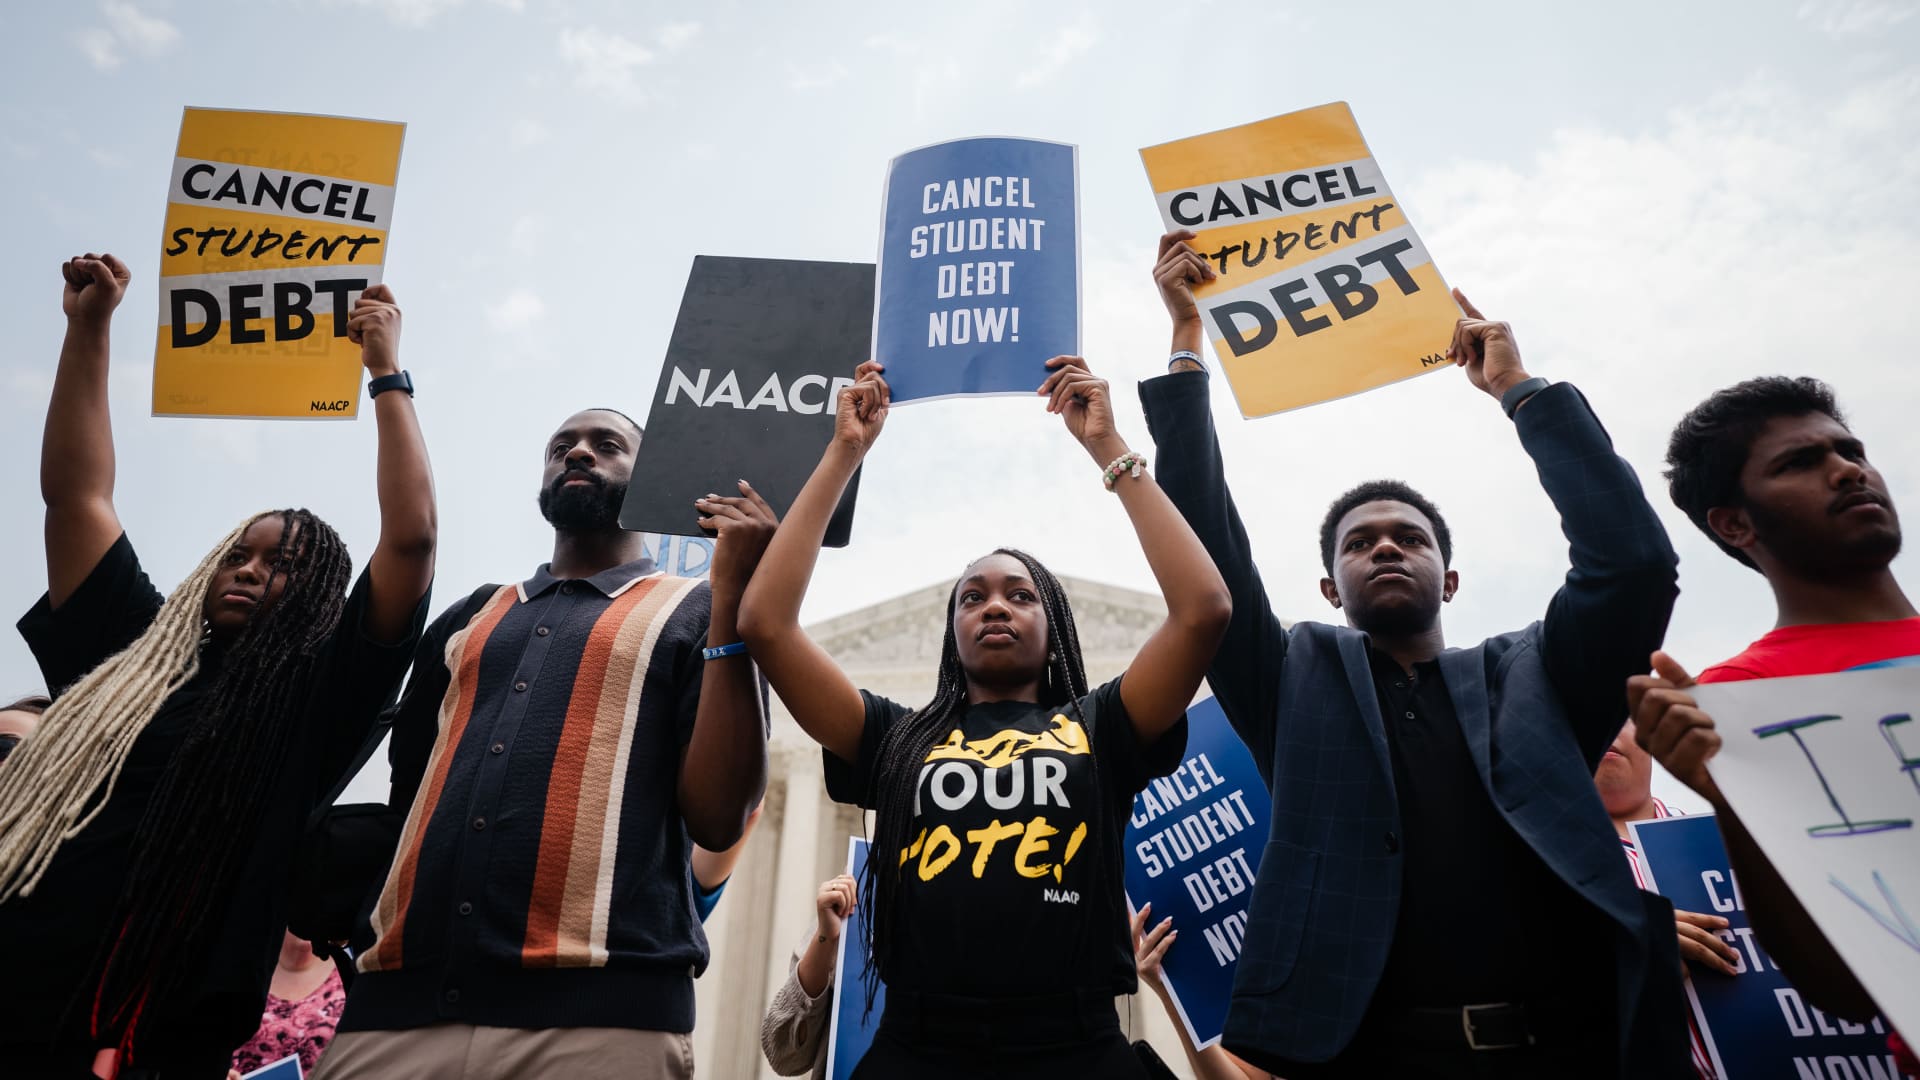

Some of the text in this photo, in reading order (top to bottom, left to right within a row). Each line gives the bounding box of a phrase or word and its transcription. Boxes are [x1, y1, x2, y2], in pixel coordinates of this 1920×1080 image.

[182, 164, 376, 223] CANCEL
[922, 176, 1035, 214] CANCEL
[1170, 166, 1376, 226] CANCEL
[166, 227, 380, 263] STUDENT
[910, 218, 1045, 258] STUDENT
[1196, 203, 1394, 275] TUDENT
[937, 261, 1014, 299] DEBT
[1209, 238, 1421, 358] DEBT
[171, 279, 367, 348] DEBT
[928, 307, 1019, 347] NOW!
[311, 400, 349, 411] NAACP
[1136, 789, 1255, 878] STUDENT
[1183, 848, 1255, 914] DEBT
